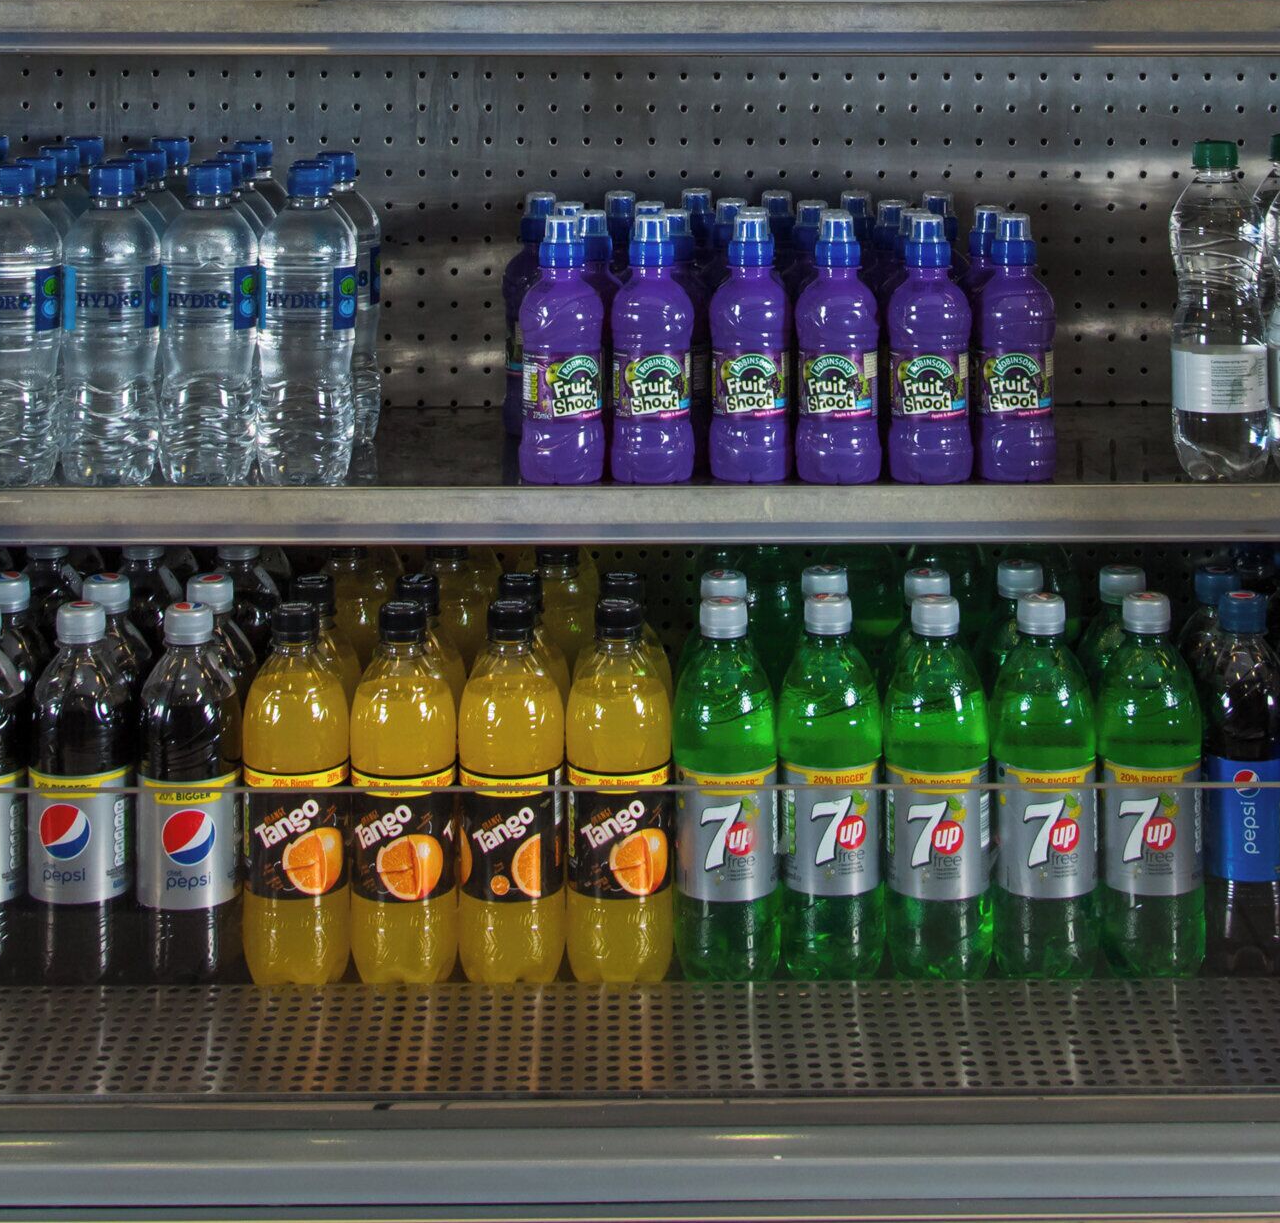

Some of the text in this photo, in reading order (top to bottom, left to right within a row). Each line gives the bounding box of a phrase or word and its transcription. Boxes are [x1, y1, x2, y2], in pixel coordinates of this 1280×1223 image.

[553, 379, 592, 398] Fruit
[632, 377, 672, 397] Fruit
[726, 376, 767, 396] Fruit
[808, 376, 847, 396] Fruit
[903, 377, 943, 396] Fruit
[990, 376, 1030, 394] Fruit
[553, 393, 597, 414] Shoot
[632, 392, 677, 413] Shoot
[727, 391, 772, 412] Shoot
[808, 392, 853, 412] Shoot
[904, 393, 950, 412] Shoot
[990, 391, 1036, 411] Shoot
[813, 773, 865, 785] 20% BIGGER
[1120, 773, 1140, 783] 20%
[175, 792, 211, 801] BIGGER
[255, 799, 319, 849] Tango
[355, 804, 412, 849] Tango
[473, 807, 535, 854] Tango
[580, 800, 645, 849] Tango
[1240, 802, 1260, 855] pepsi
[726, 853, 756, 867] free
[837, 847, 866, 863] free
[933, 853, 962, 867] free
[1050, 851, 1079, 865] free
[1144, 849, 1174, 863] free
[42, 868, 86, 885] pepsi
[167, 871, 212, 891] pepsi
